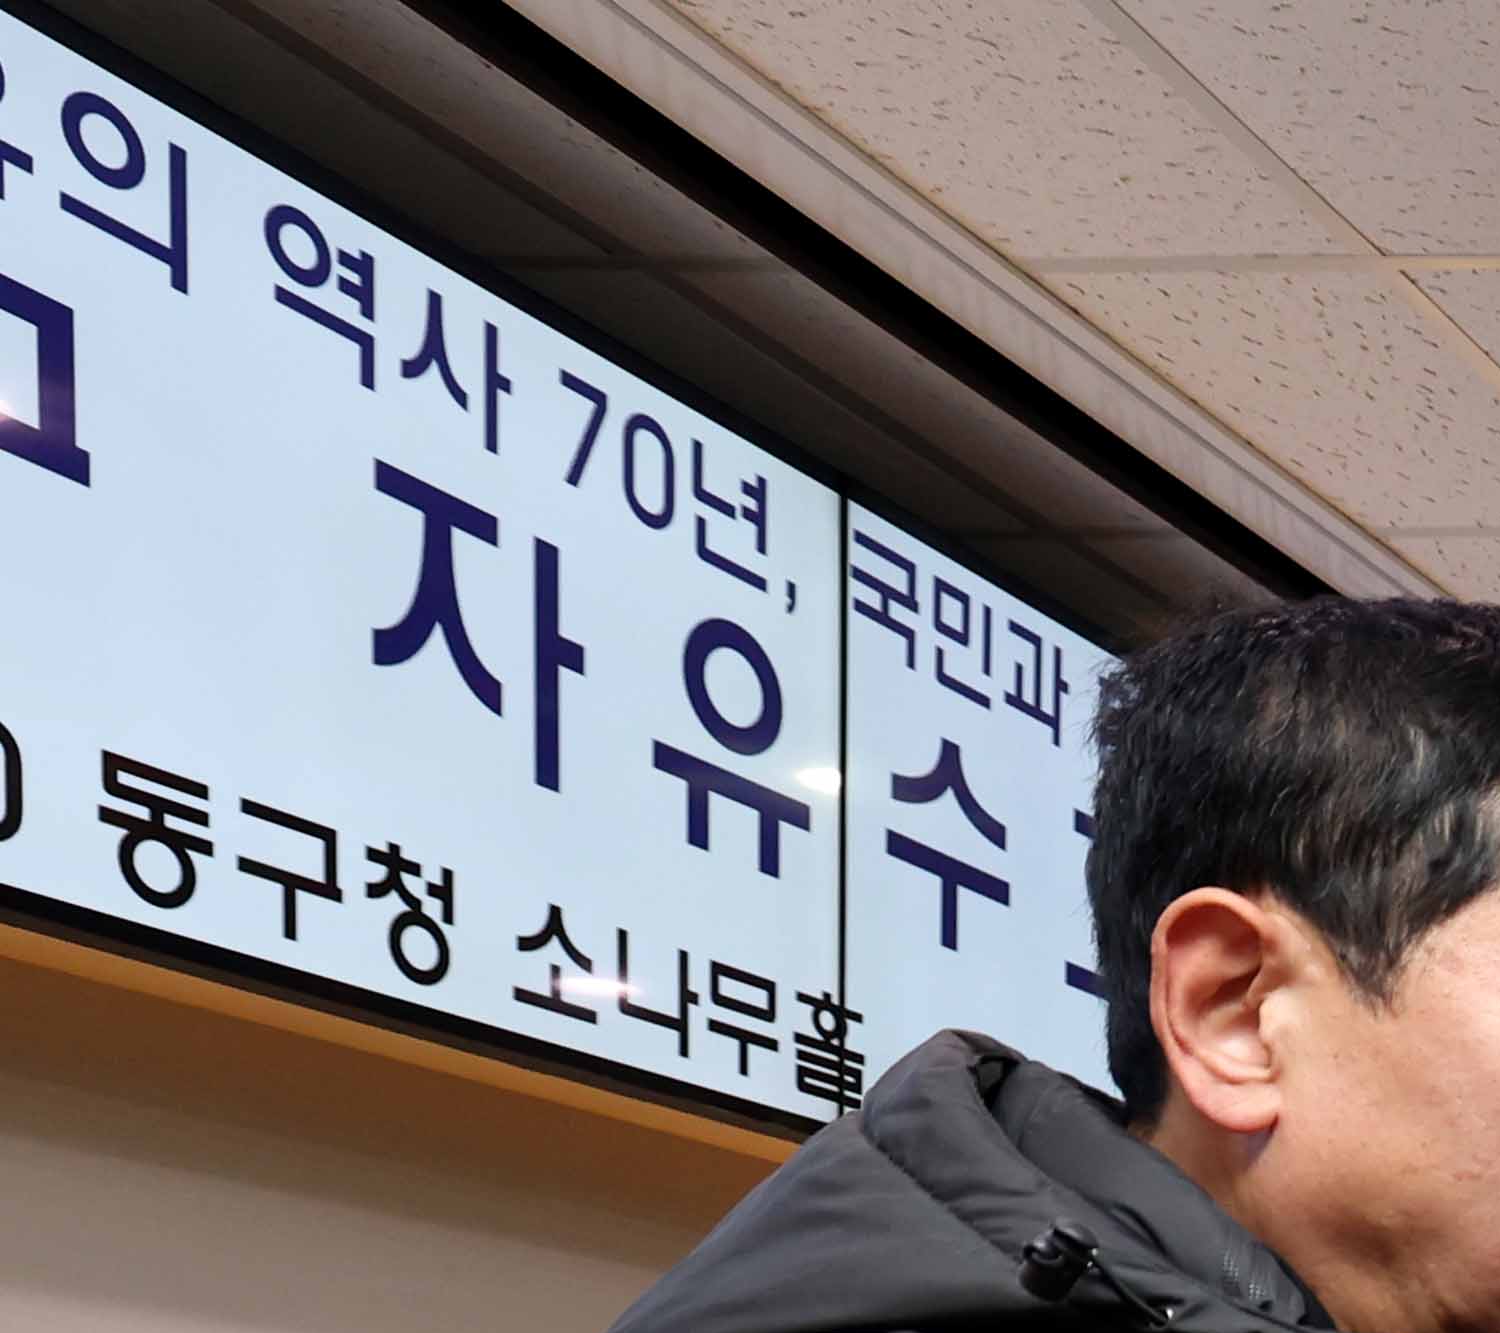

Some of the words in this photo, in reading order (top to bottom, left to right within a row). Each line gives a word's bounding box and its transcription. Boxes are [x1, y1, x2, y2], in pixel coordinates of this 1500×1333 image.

[263, 203, 513, 456] 역사
[559, 368, 797, 615] 70년,
[849, 528, 1070, 748] 국민과
[97, 749, 456, 988] 동구청
[512, 902, 865, 1112] 소나무홀
